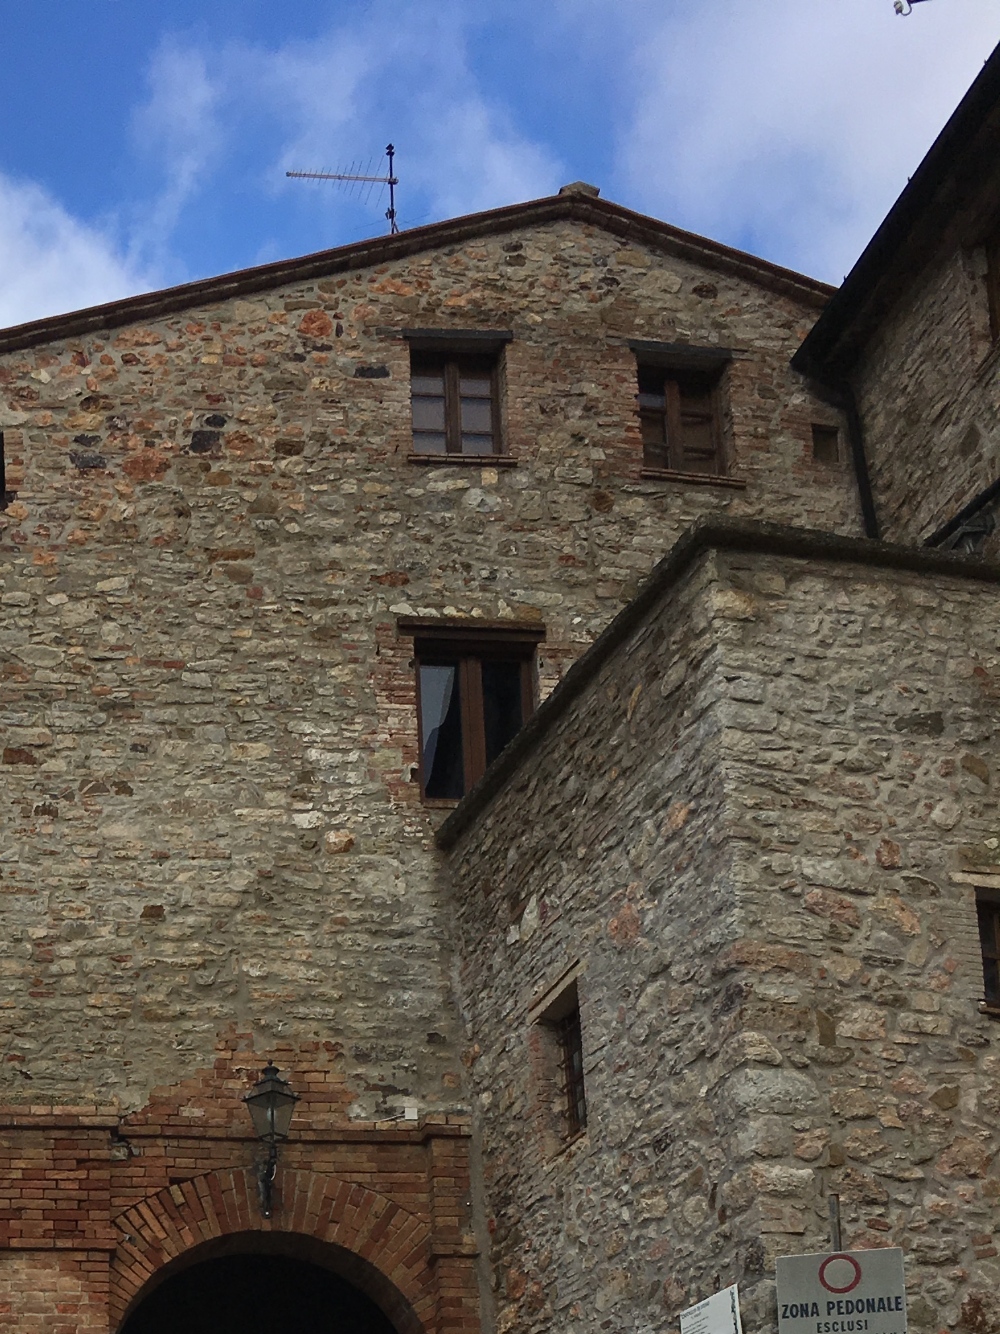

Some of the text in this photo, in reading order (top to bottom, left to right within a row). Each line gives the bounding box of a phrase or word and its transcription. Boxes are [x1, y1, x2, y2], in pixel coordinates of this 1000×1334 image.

[782, 1296, 903, 1319] ZONA PEDONALE
[817, 1319, 868, 1333] ESCLUSI
